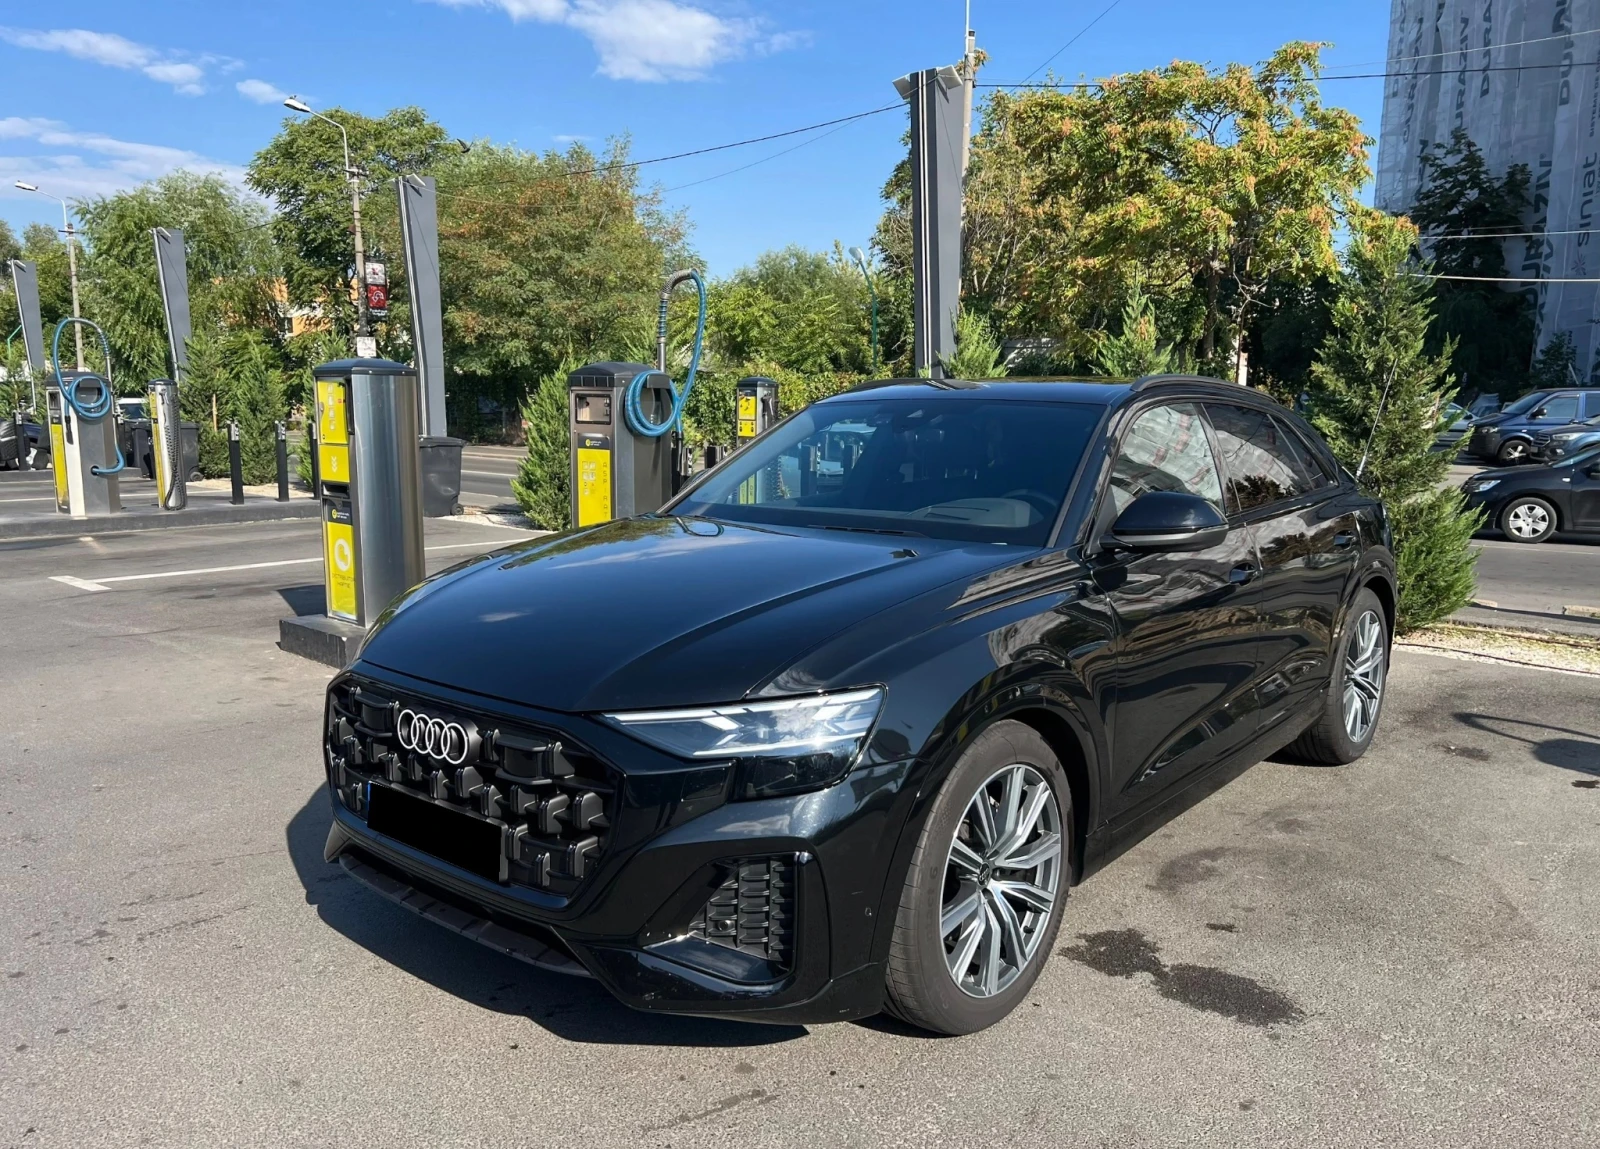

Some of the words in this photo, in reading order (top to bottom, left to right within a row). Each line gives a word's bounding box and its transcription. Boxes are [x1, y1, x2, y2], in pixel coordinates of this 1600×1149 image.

[1455, 17, 1469, 131] URAZIV
[1480, 0, 1492, 98] DURA
[1577, 152, 1597, 247] siniat
[929, 865, 939, 880] 6
